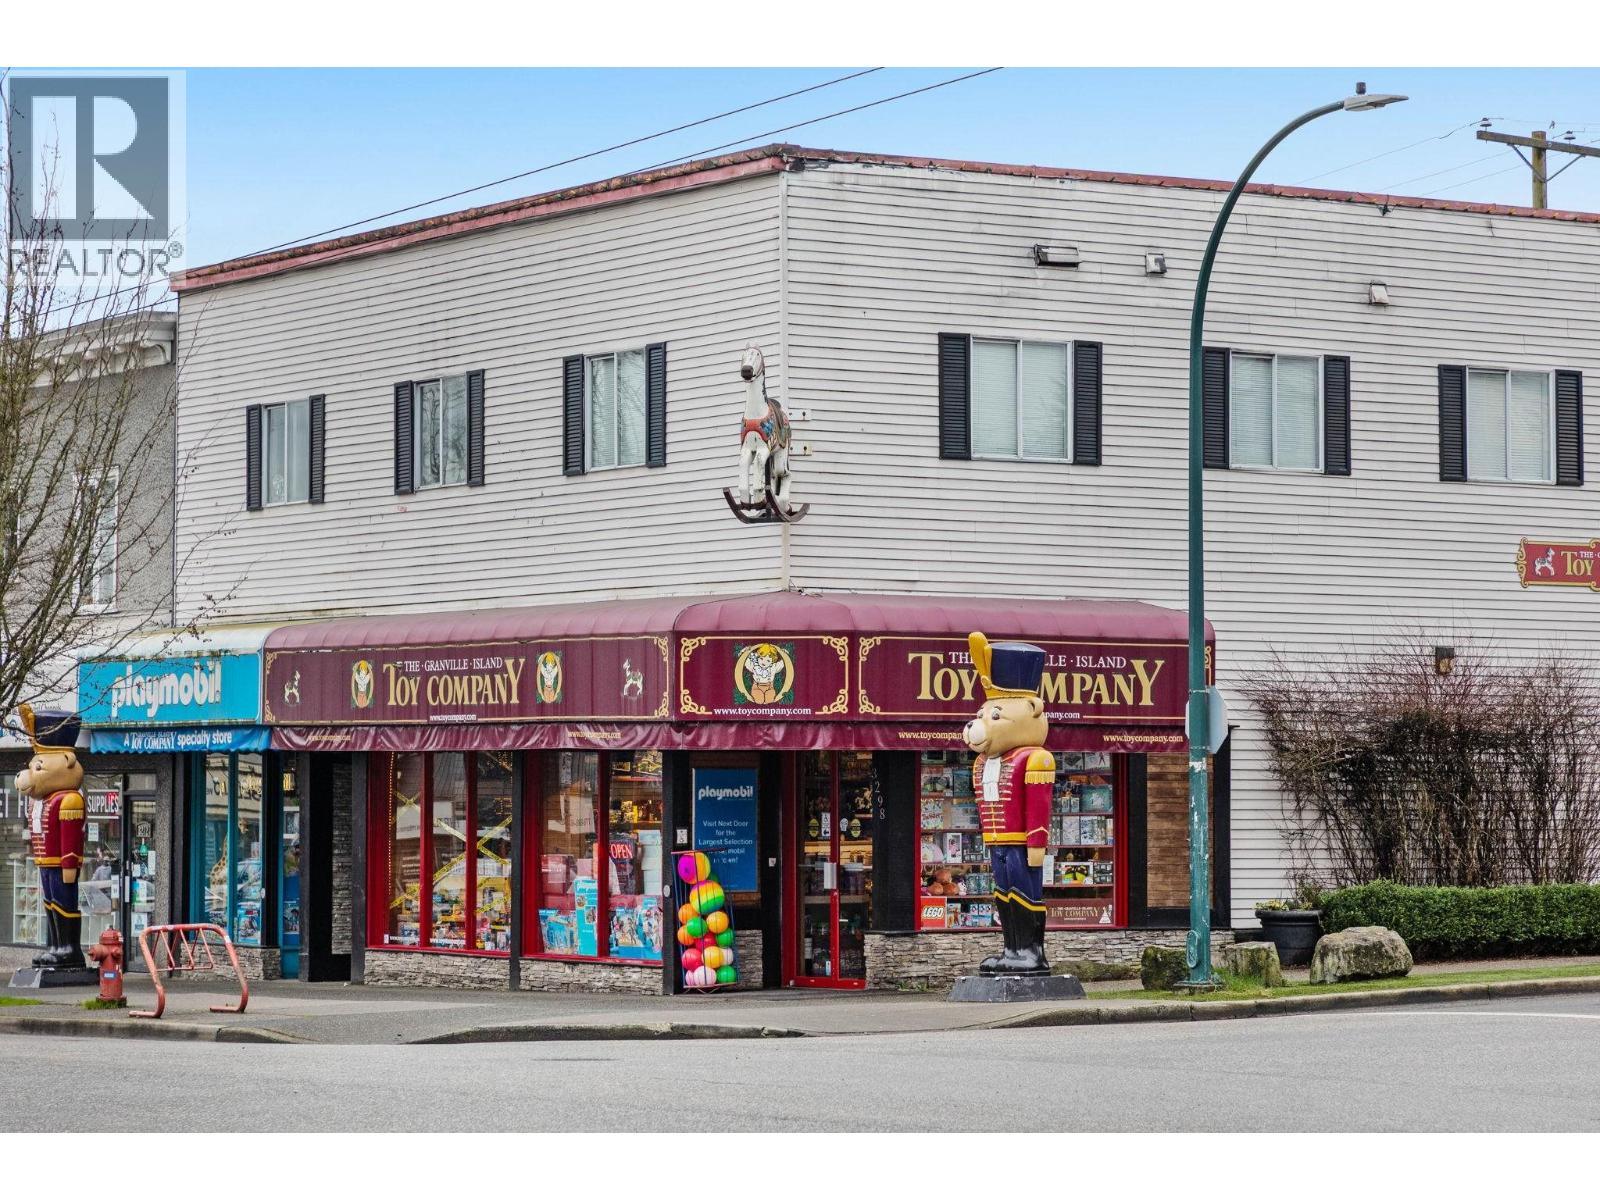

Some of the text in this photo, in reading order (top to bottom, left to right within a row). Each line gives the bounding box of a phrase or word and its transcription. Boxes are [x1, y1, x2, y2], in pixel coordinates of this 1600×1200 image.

[1580, 551, 1594, 559] THE
[404, 657, 503, 672] THE GRANVILLE ISLAND
[1076, 656, 1127, 669] ISLAND
[383, 658, 526, 706] TOY COMPANY
[908, 652, 1165, 706] TOY MPANY
[111, 660, 221, 717] playmobil
[714, 707, 812, 717] www.toycompany.com
[123, 733, 130, 746] A
[177, 730, 211, 748] specialty
[212, 729, 233, 744] store
[898, 731, 963, 741] www.toycompan
[1103, 735, 1183, 744] www.toycompany.com
[698, 785, 753, 800] playmobil
[87, 794, 119, 813] SUPPLIES
[698, 839, 723, 847] Largest
[610, 843, 633, 859] OPEN
[922, 906, 945, 918] LEGO
